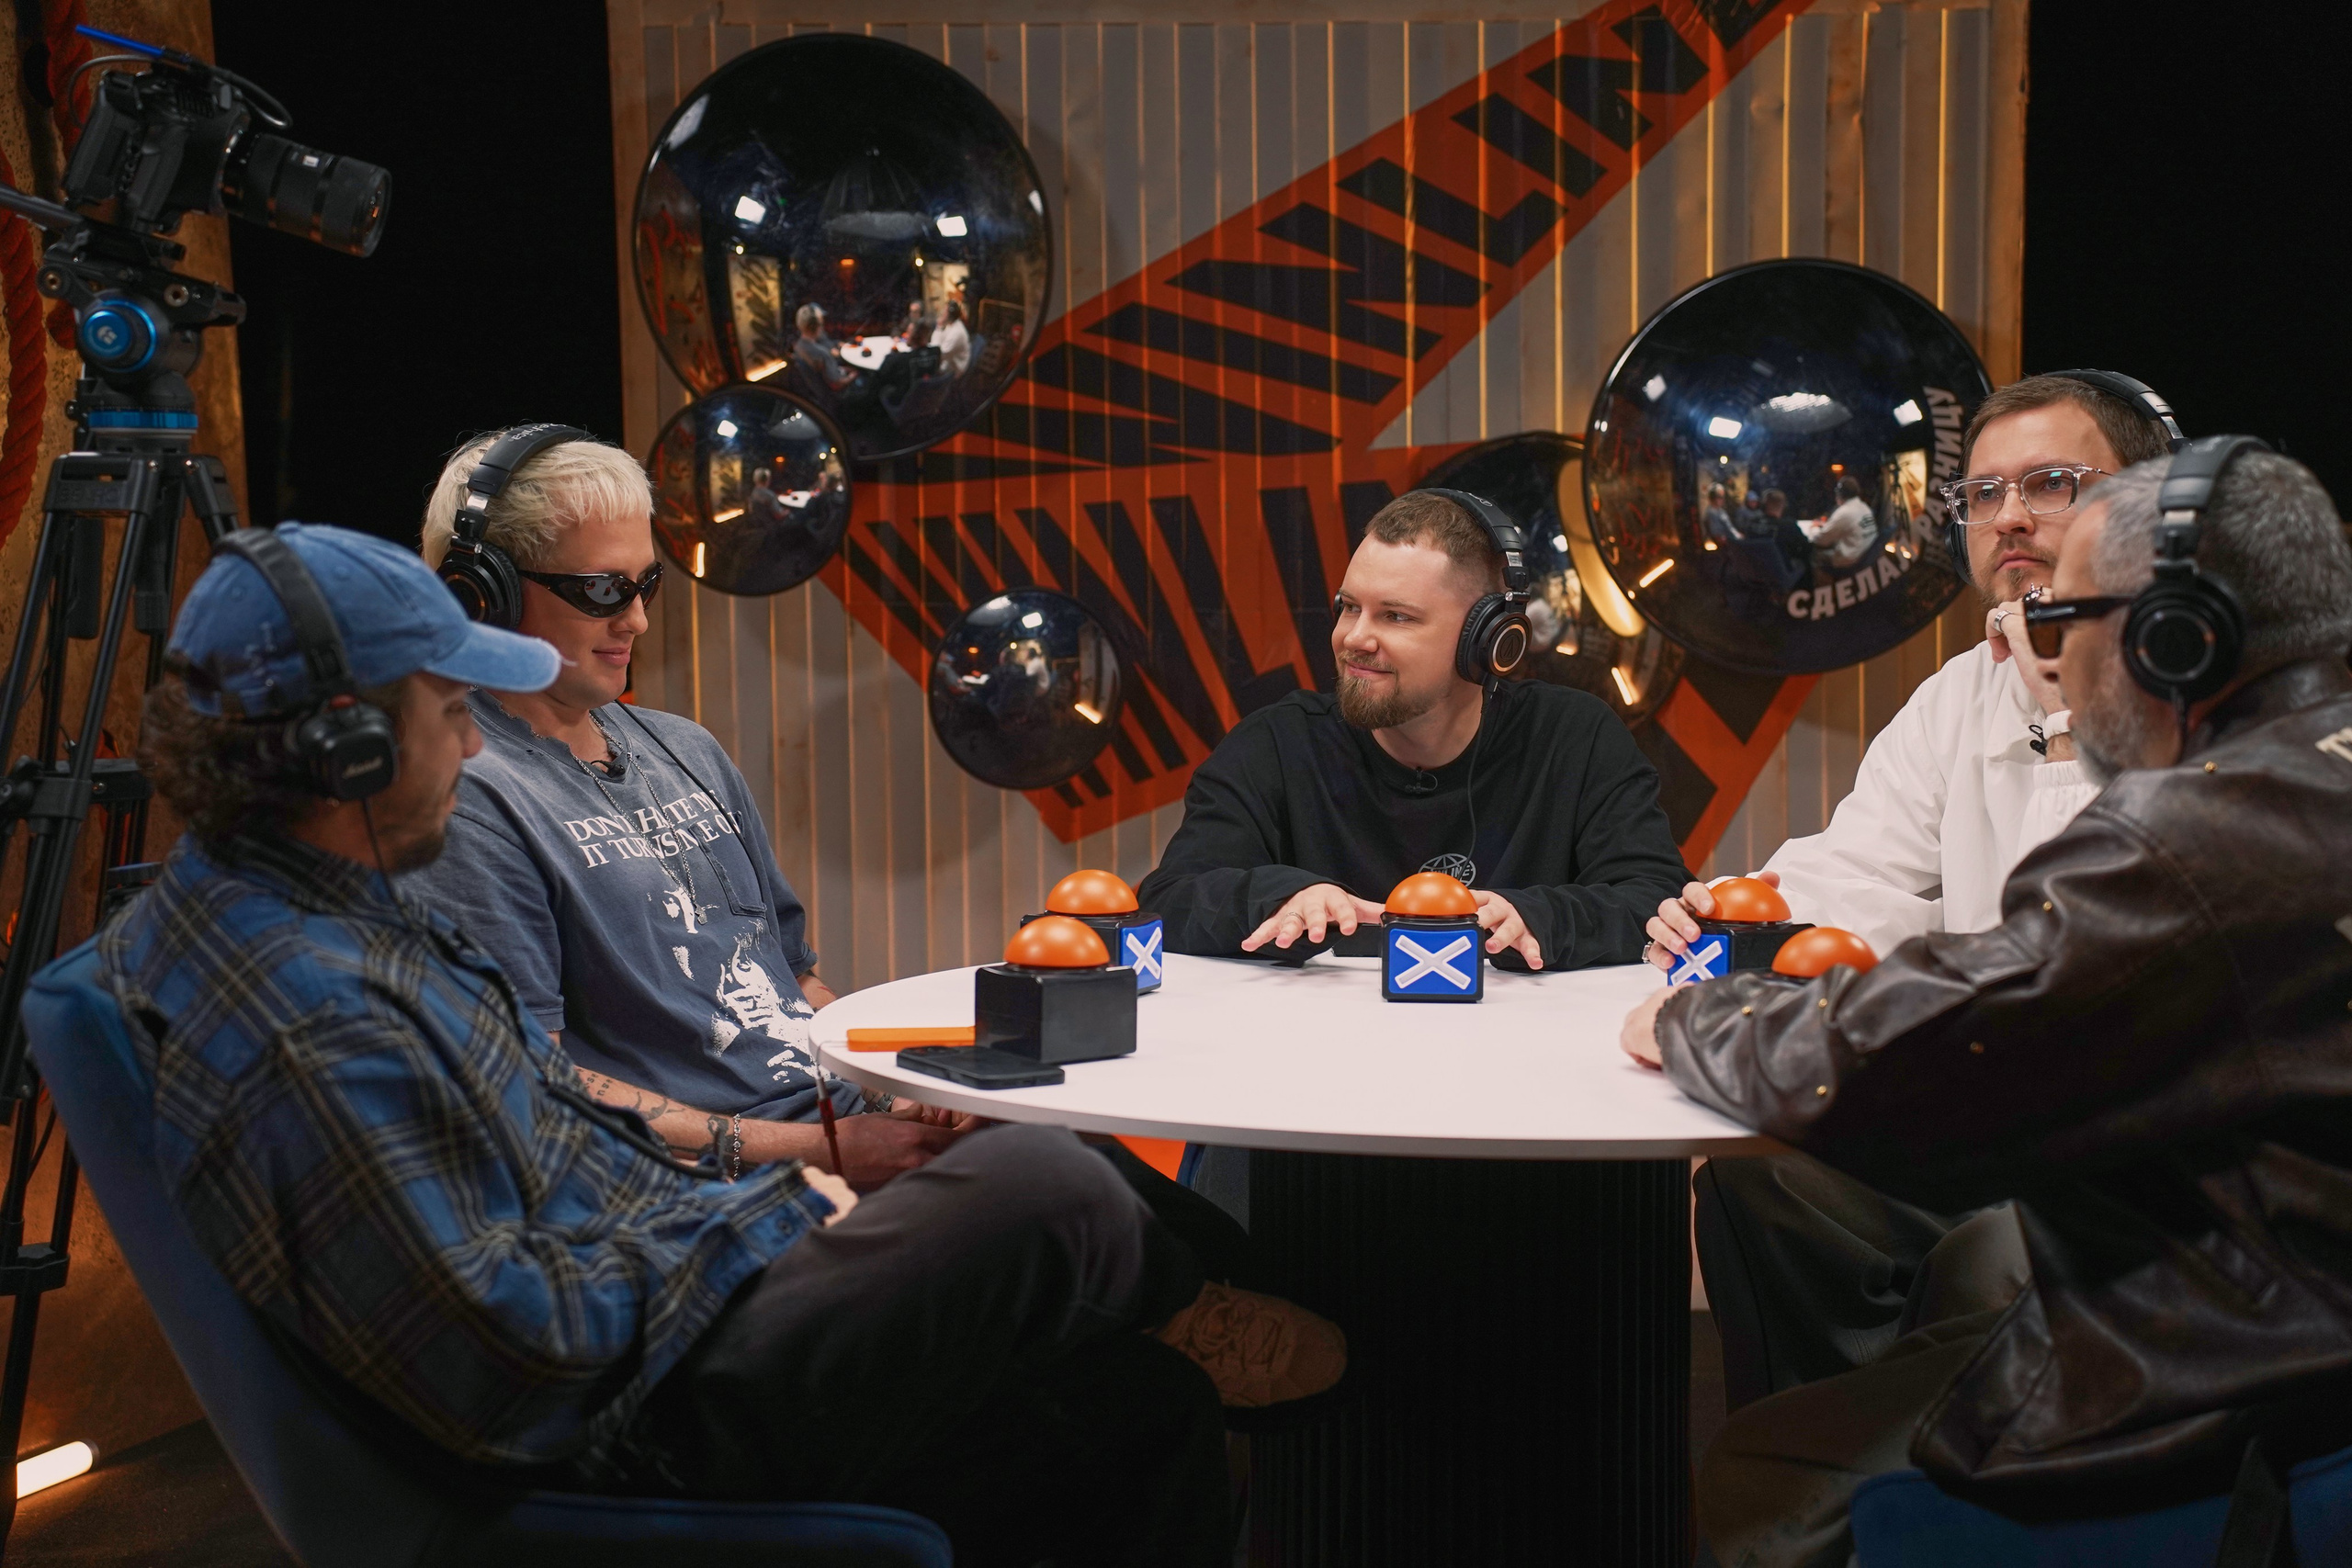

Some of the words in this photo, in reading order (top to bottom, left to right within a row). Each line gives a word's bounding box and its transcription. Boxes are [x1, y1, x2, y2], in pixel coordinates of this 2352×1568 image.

[1787, 530, 1919, 621] СДЕЛАЛ
[1910, 385, 1964, 548] РАЗНИЦУ
[634, 797, 699, 834] HATE
[578, 842, 610, 869] IT
[606, 831, 680, 860] TURNS
